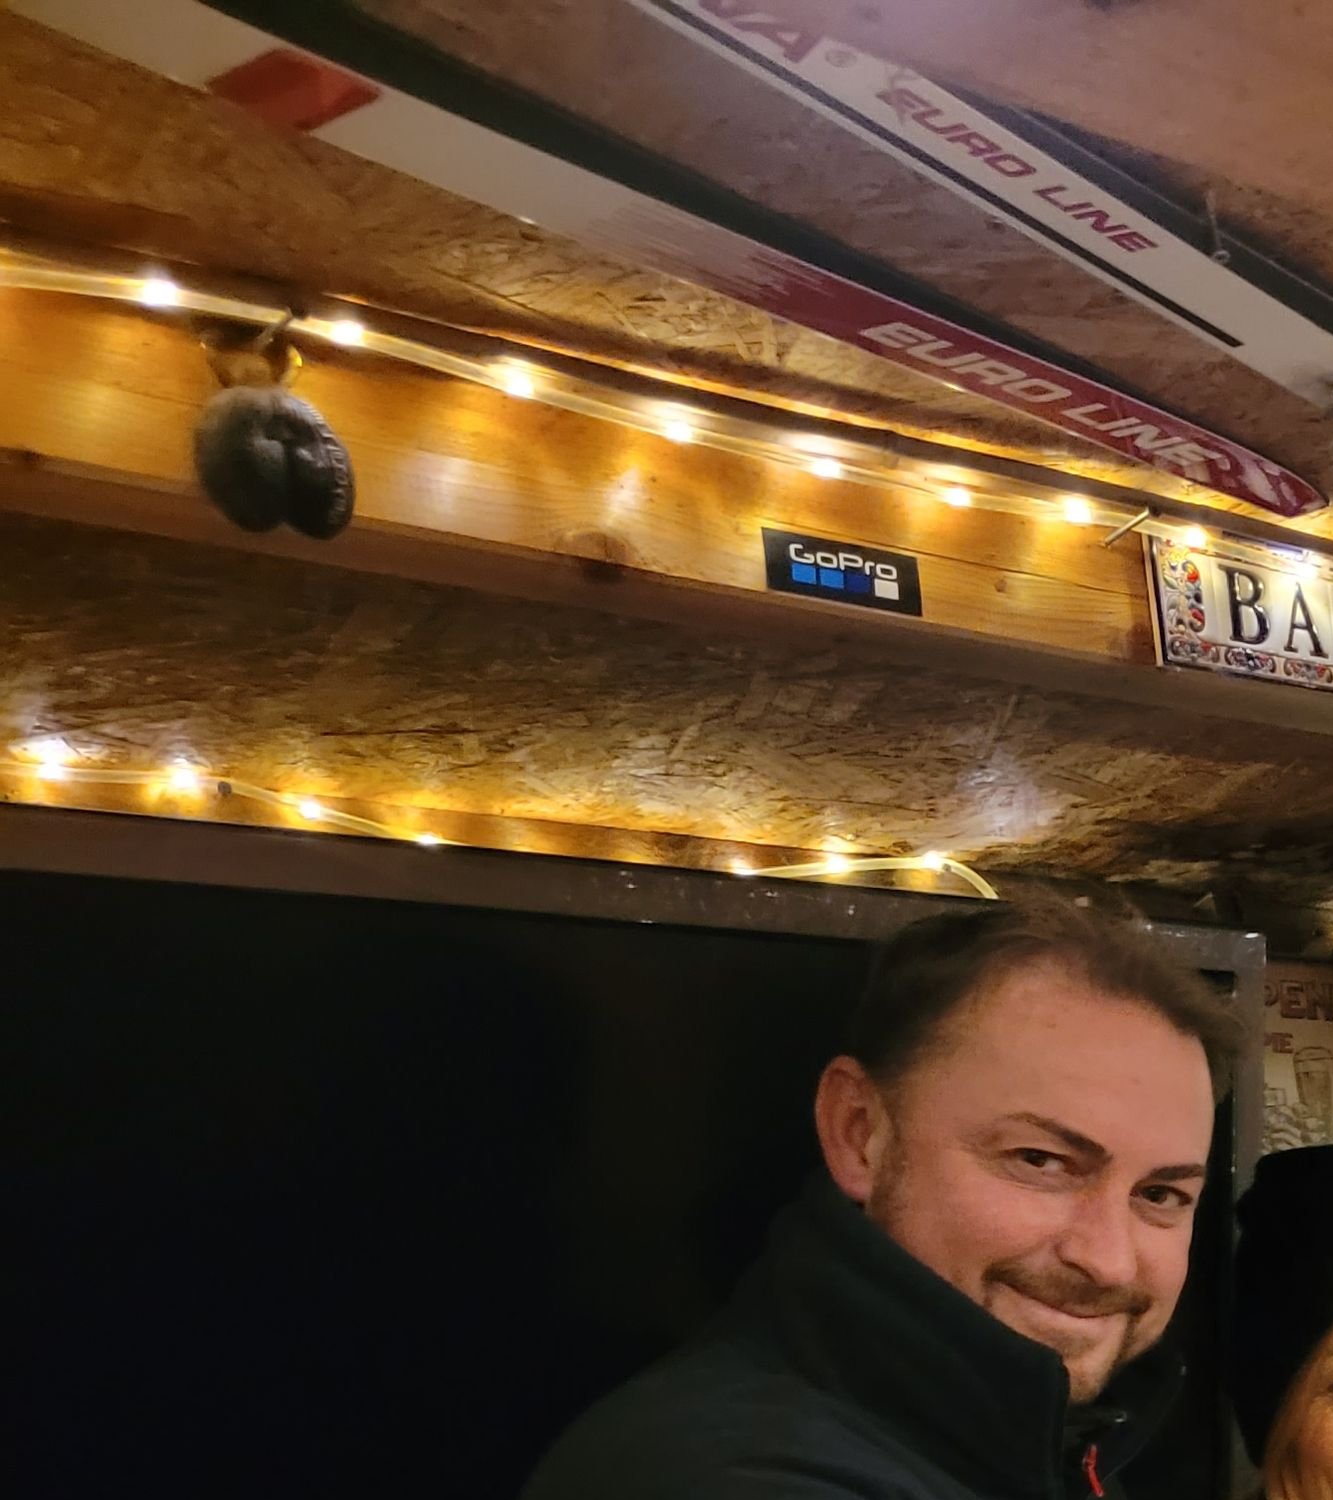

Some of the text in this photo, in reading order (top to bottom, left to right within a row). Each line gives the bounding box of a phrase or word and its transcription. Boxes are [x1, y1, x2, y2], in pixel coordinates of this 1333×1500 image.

[875, 87, 1158, 253] EURO LINE
[859, 321, 1224, 480] EURO LINE
[788, 542, 899, 581] GoPro
